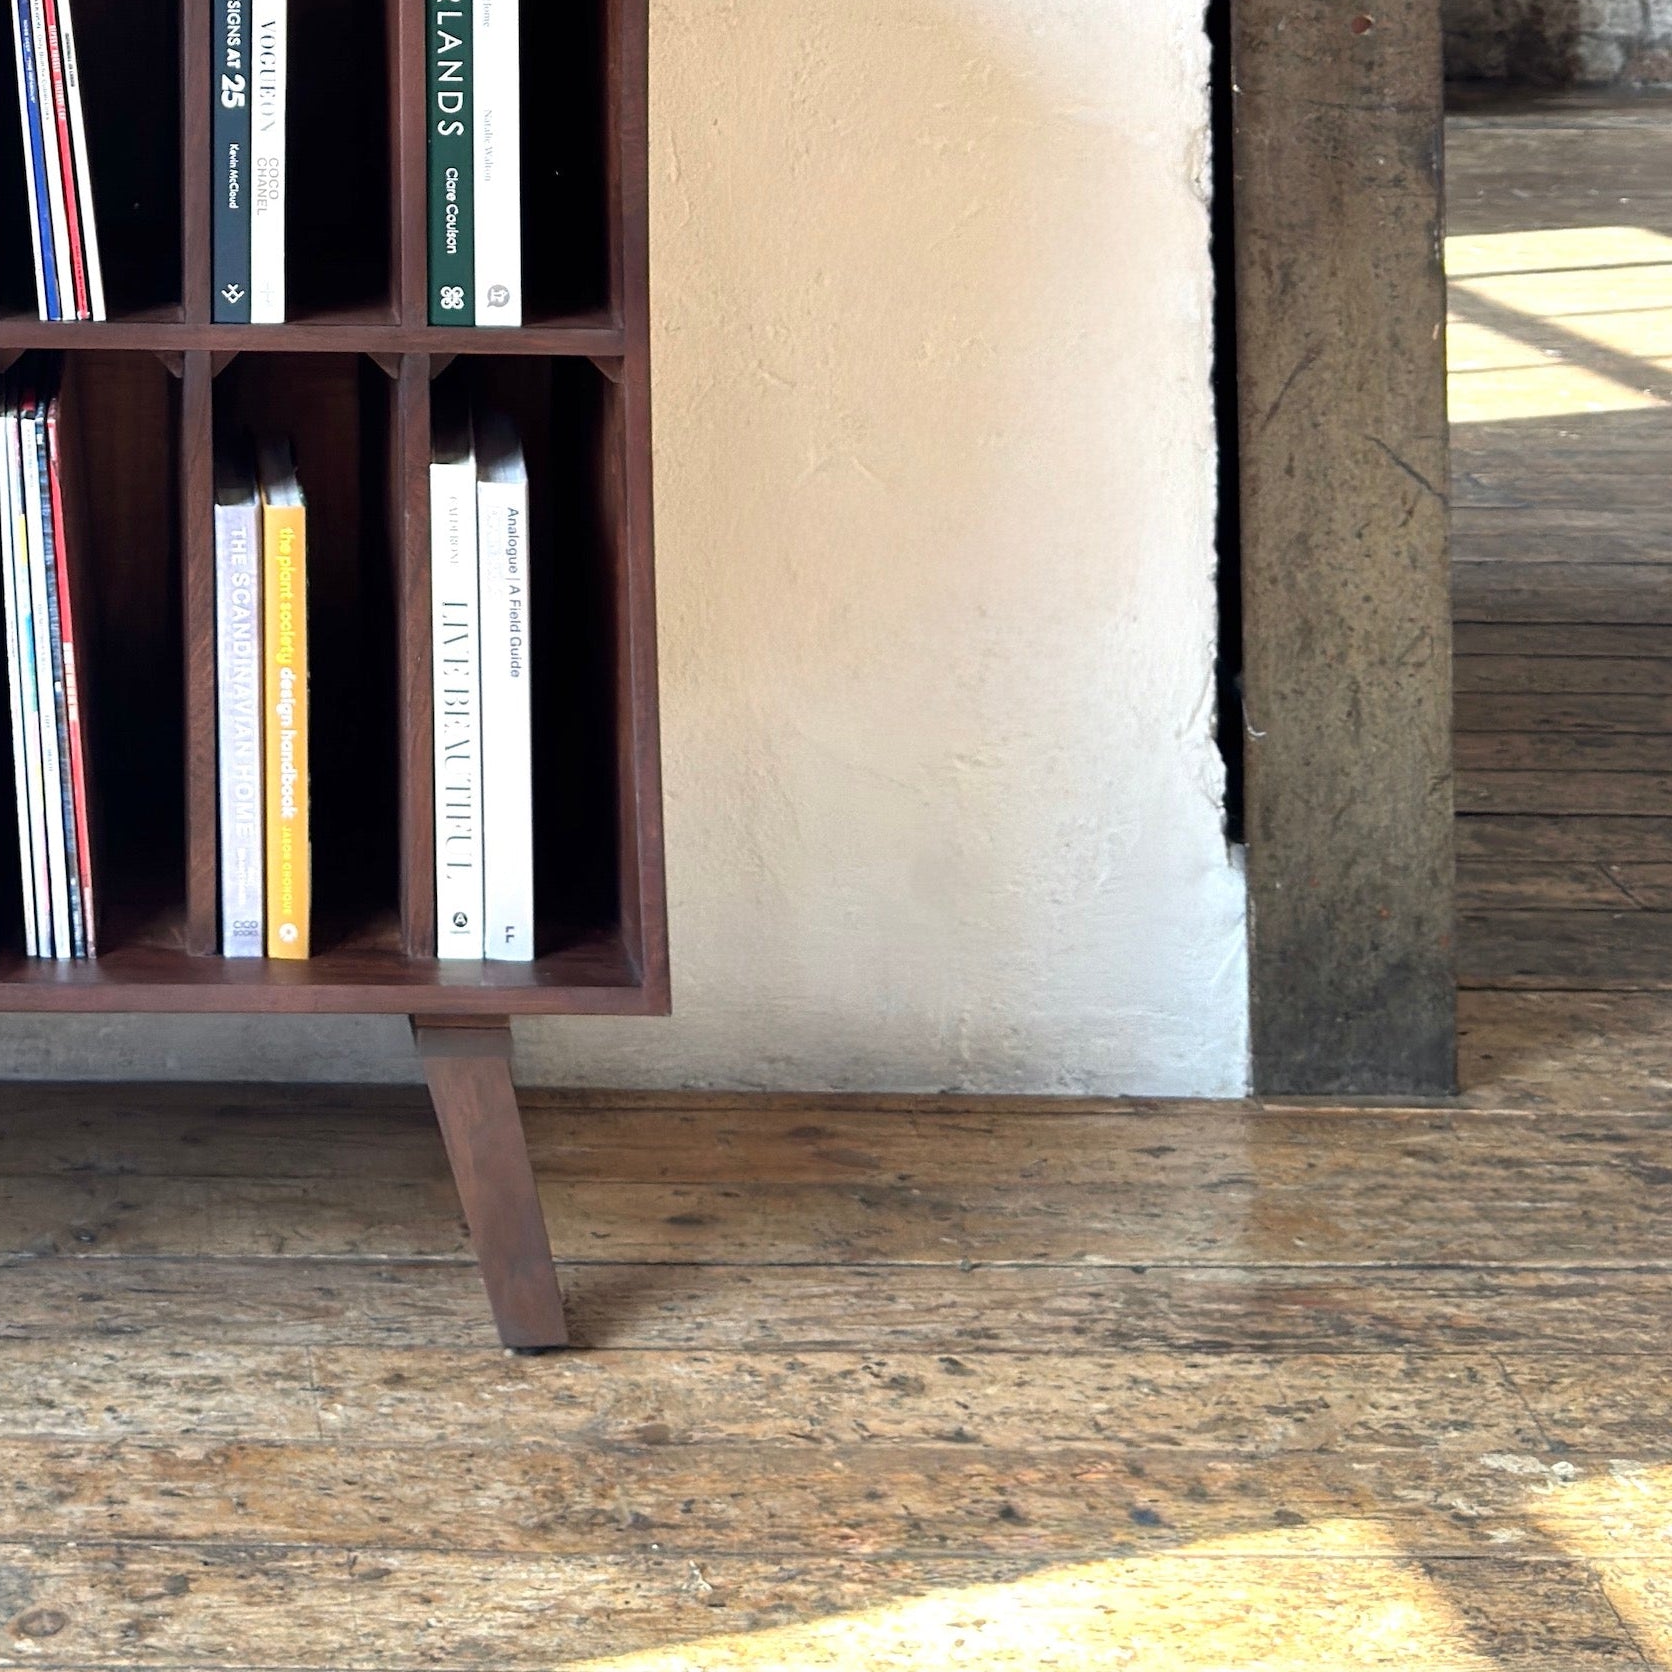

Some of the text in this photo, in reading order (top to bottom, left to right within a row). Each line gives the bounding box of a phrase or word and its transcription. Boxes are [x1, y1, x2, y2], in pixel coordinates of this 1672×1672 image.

[227, 47, 241, 69] AT
[221, 73, 246, 109] 25
[229, 143, 239, 209] Kevin McCloud
[257, 157, 268, 216] CHANEL
[268, 157, 279, 200] COCO
[483, 144, 494, 181] Walton
[446, 167, 459, 254] Clare Coulson
[231, 526, 248, 566] THE
[506, 507, 523, 678] Analogue A Field Guide
[231, 571, 254, 759] SCANDINAVIAN
[275, 527, 298, 819] the plant society design handbook
[442, 602, 472, 880] LIVE BEAUTIFUL
[234, 763, 254, 839] HOME
[233, 920, 258, 929] CICO
